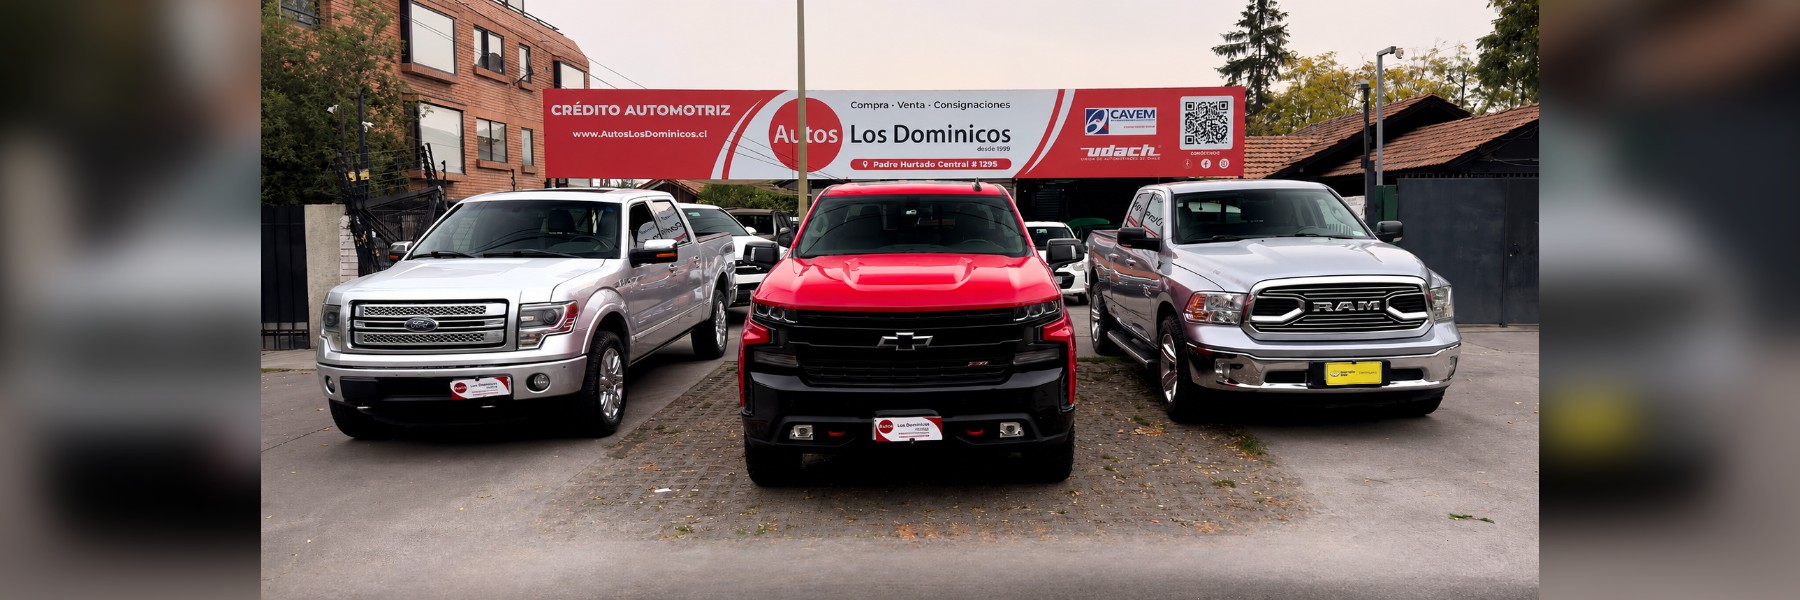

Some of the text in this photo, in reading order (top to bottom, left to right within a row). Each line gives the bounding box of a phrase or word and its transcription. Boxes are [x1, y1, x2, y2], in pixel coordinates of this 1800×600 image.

[551, 101, 731, 116] CRÉDITO AUTOMOTRIZ
[850, 101, 1011, 111] Compra Venta Consignaciones
[1110, 109, 1156, 119] CAVEM
[572, 129, 708, 139] www.AutosLosDominicos.cl
[773, 124, 1011, 144] Autos Los Dominicos
[1080, 144, 1161, 157] udach
[873, 160, 898, 169] Padre
[900, 160, 936, 169] Hurtado
[938, 160, 969, 169] Central
[979, 160, 998, 168] 1295
[1312, 300, 1380, 311] RAM
